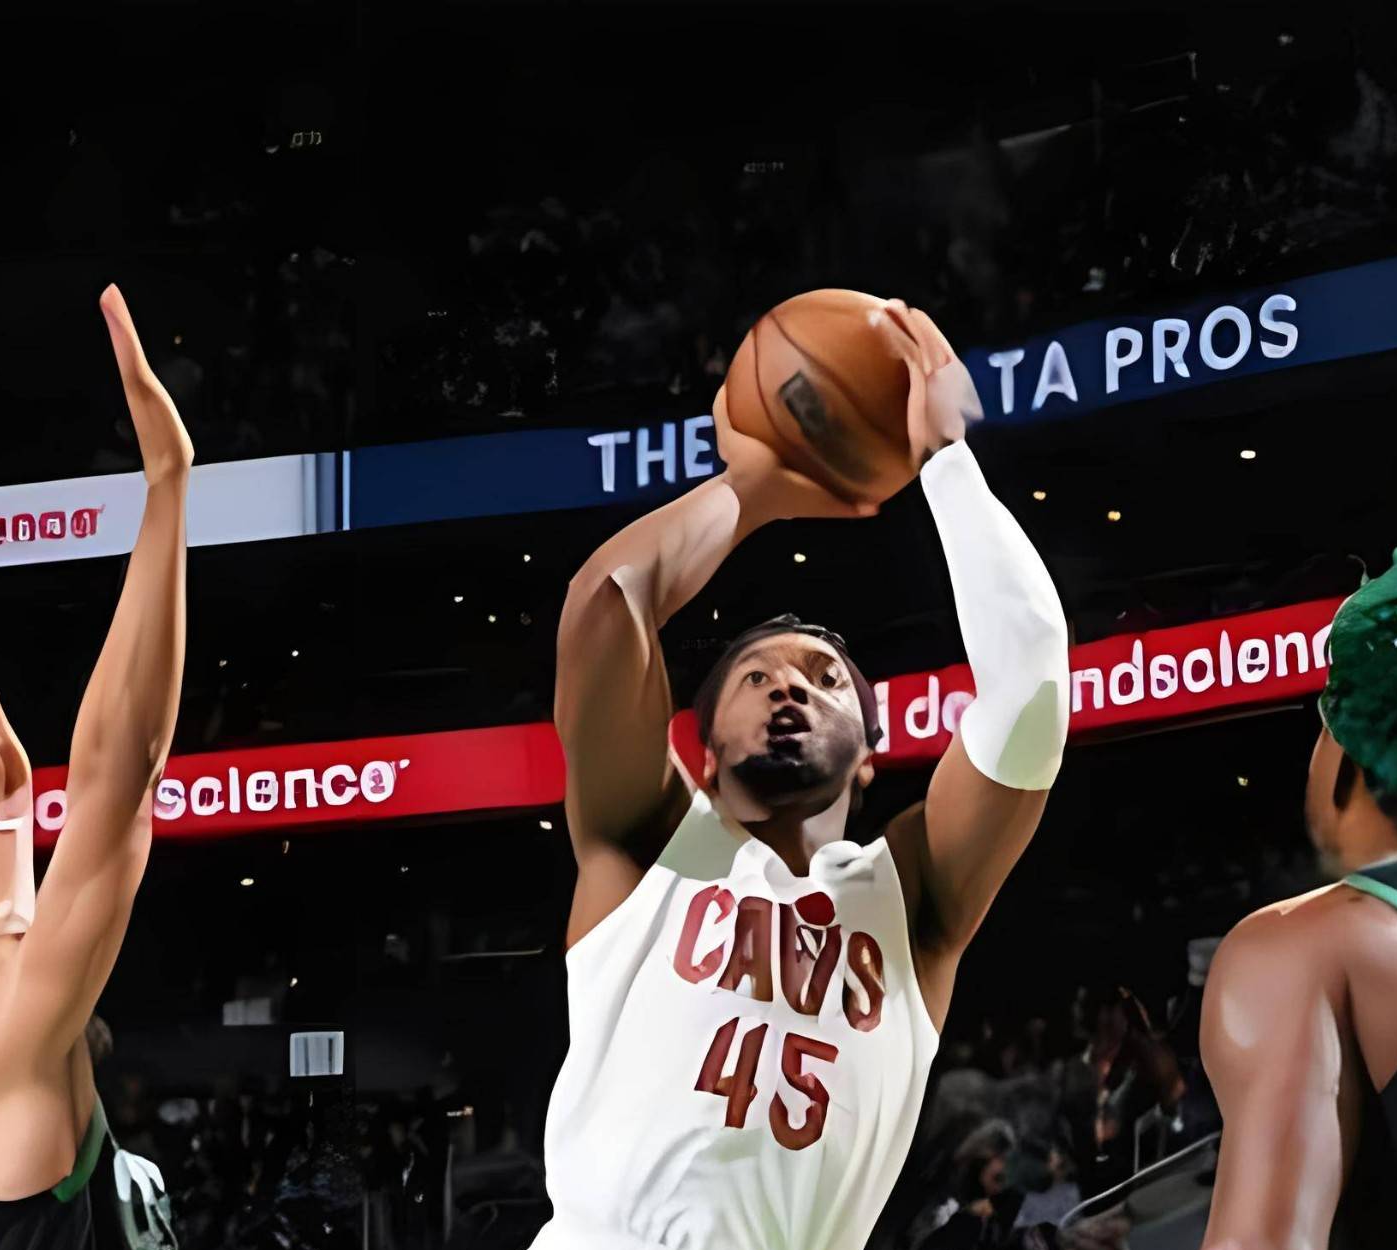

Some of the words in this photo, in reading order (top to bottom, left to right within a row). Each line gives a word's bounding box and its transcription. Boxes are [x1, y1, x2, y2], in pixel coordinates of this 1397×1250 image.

[588, 413, 714, 493] THE
[1104, 294, 1299, 394] PROS
[672, 884, 886, 1033] CAVS
[693, 1016, 840, 1151] 45
